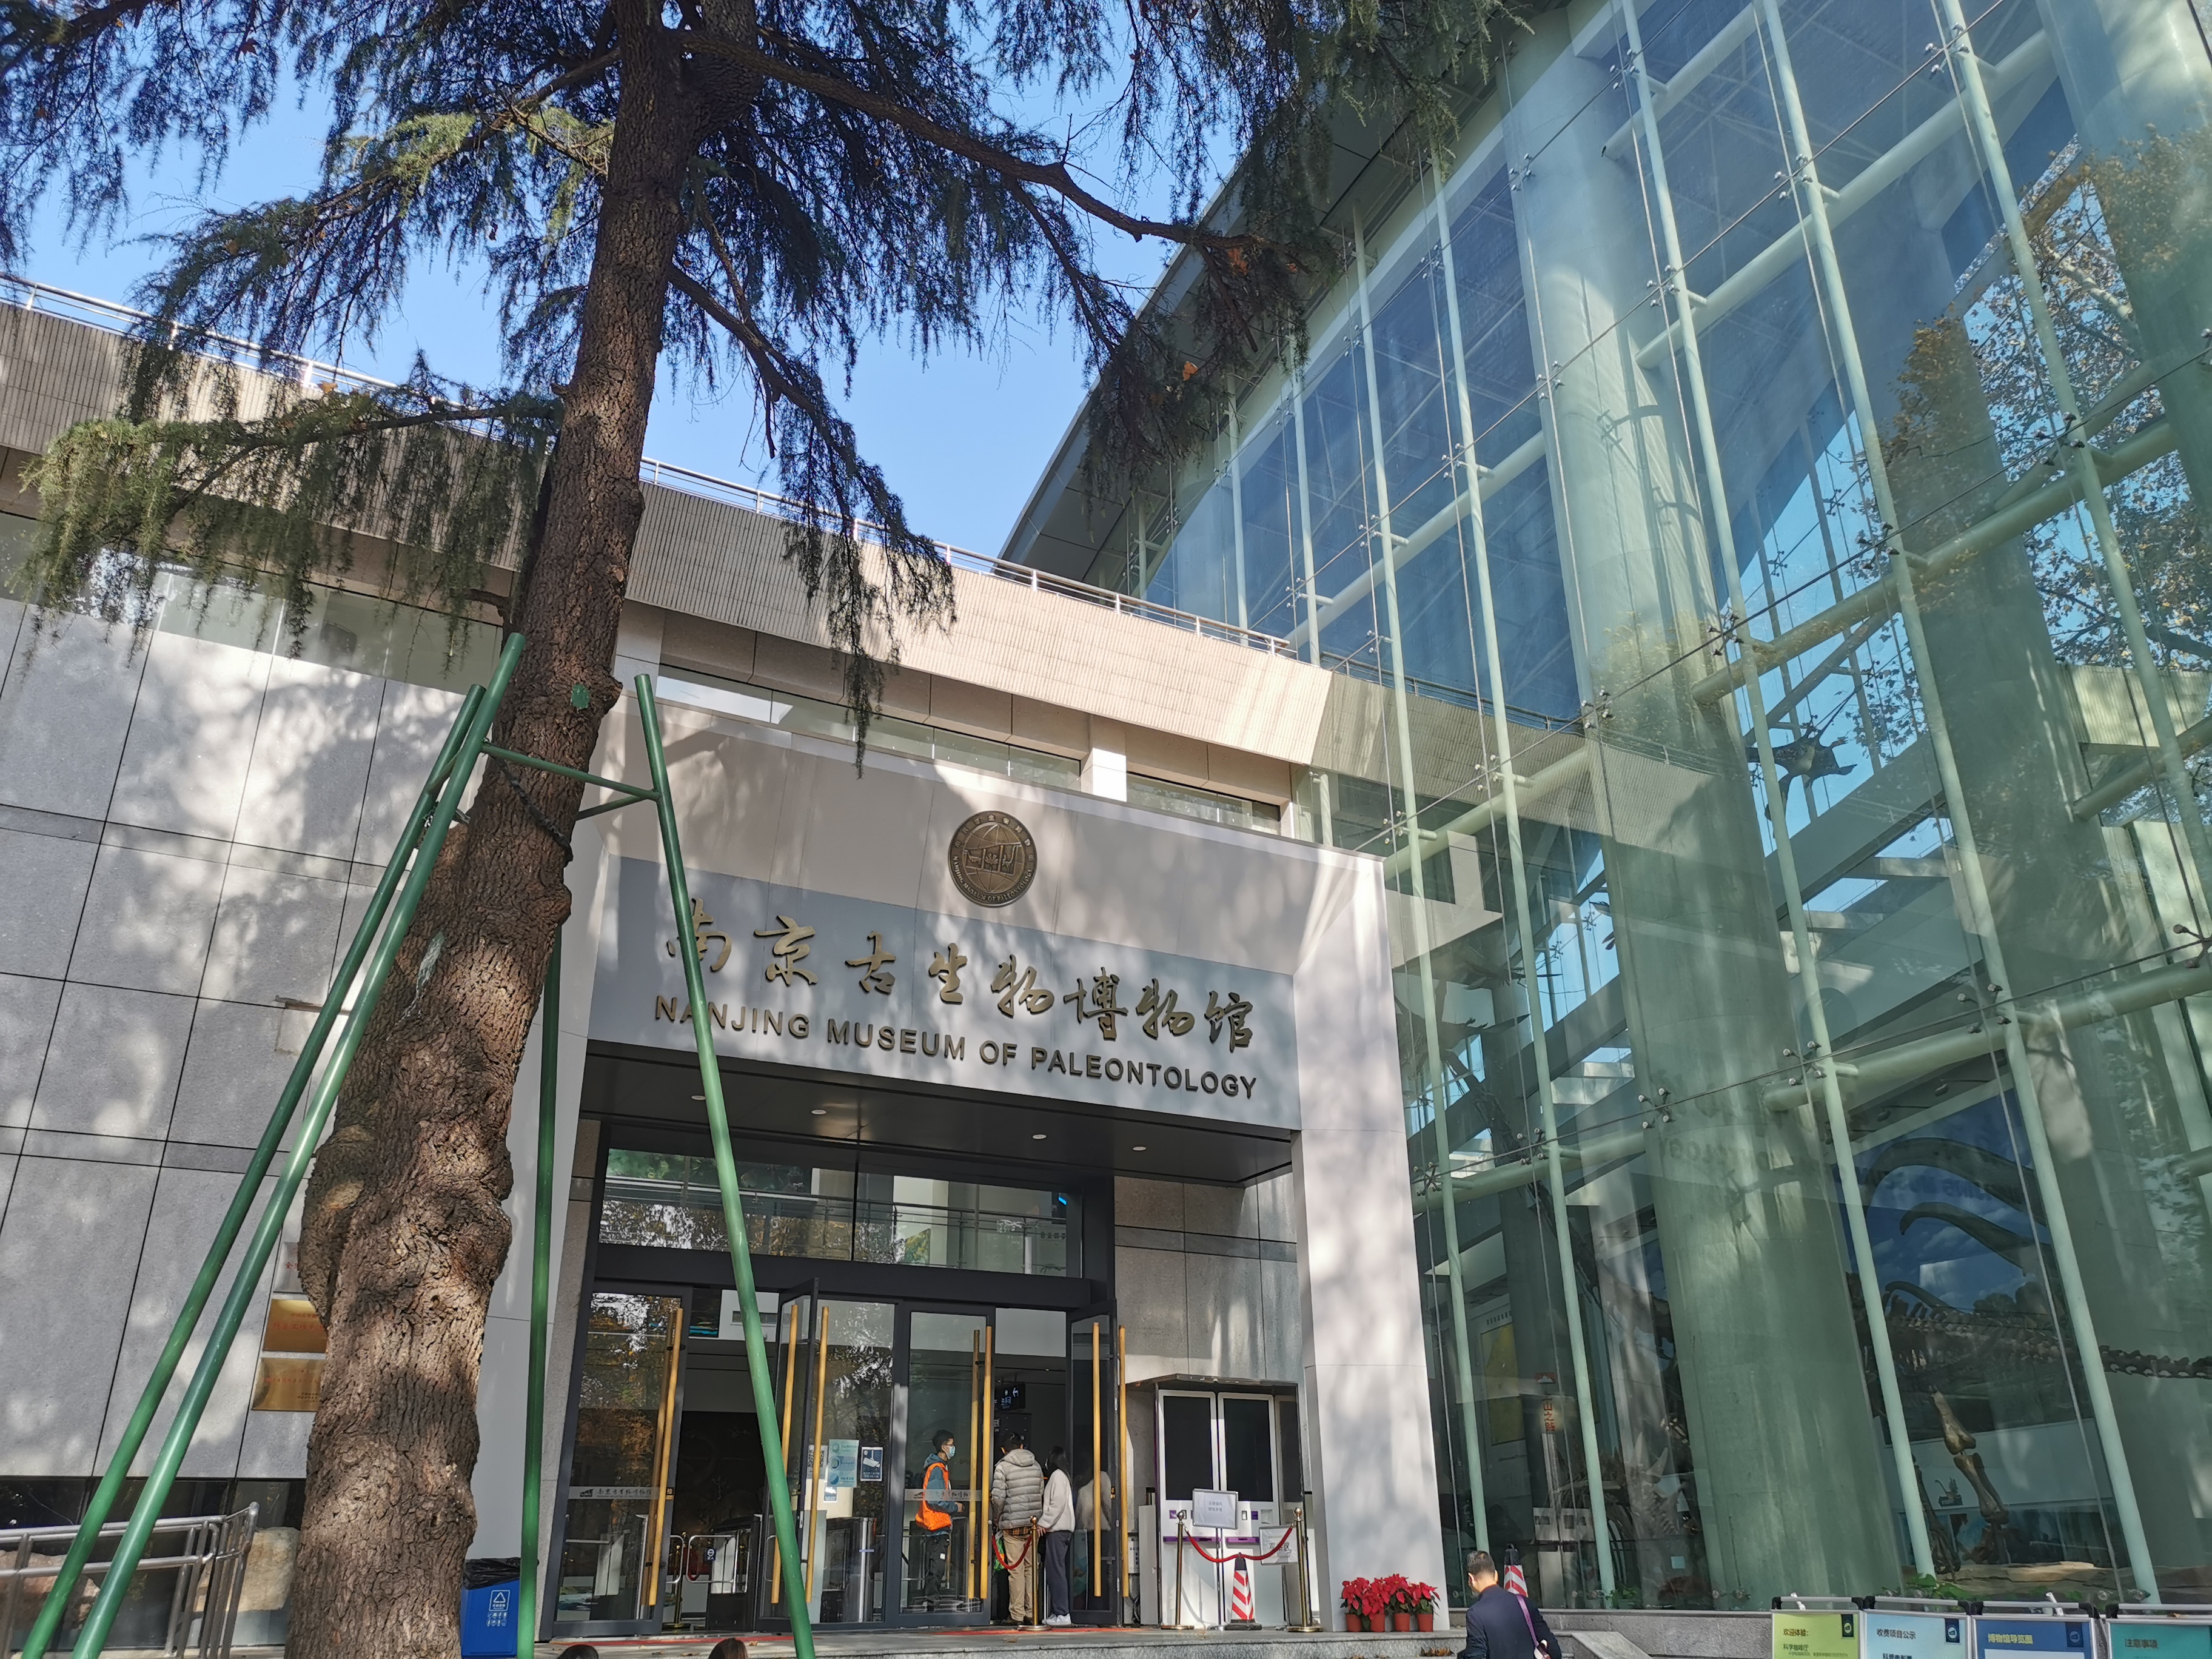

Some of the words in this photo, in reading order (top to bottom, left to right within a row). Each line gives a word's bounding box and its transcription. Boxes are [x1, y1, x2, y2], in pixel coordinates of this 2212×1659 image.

[667, 897, 1253, 1053] 南京古生物博物馆
[827, 1018, 965, 1061] MUSEUM
[979, 1040, 1017, 1066] OF
[1031, 1046, 1257, 1099] PALEONTOLOGY
[1876, 1628, 1917, 1640] 收费项目公示
[1988, 1633, 2034, 1644] 博物馆导览图
[2124, 1638, 2159, 1649] 注意事项
